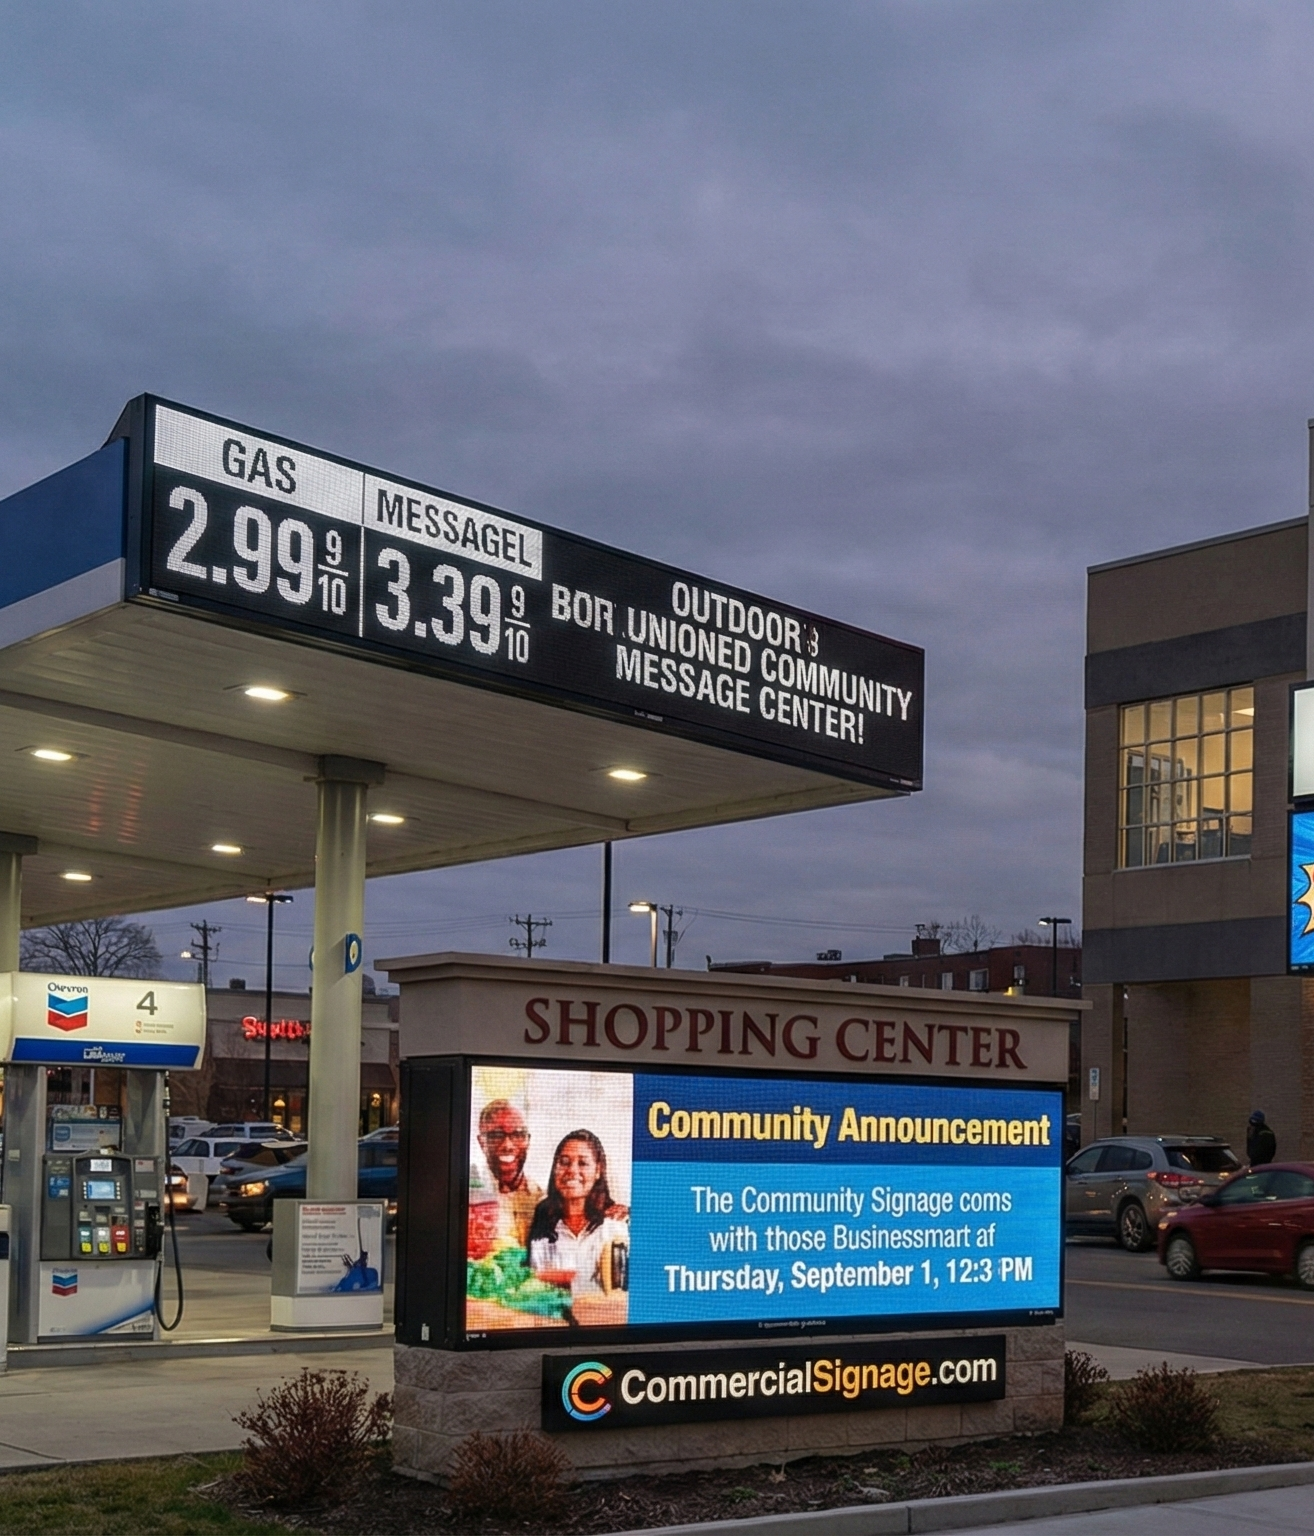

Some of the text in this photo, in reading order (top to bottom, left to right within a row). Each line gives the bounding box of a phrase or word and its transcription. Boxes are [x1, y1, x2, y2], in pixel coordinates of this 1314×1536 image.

[222, 438, 297, 495] GAS
[166, 485, 315, 605] 2.99
[375, 546, 501, 655] 3.39
[628, 606, 750, 674] UNIONED
[760, 648, 913, 721] COMMUNITY
[615, 644, 865, 744] MESSAGE CENTER!
[136, 990, 158, 1016] 4
[523, 997, 1028, 1070] SHOPPING CENTER
[648, 1101, 1051, 1149] Community Announcement
[690, 1186, 1013, 1218] The Community Signage coms
[709, 1226, 758, 1252] with
[765, 1225, 827, 1251] those
[833, 1223, 971, 1250] Businessmart
[664, 1256, 1033, 1295] Thursday, September 1, 12:3 PM
[620, 1354, 998, 1405] CommercialSignage.com
